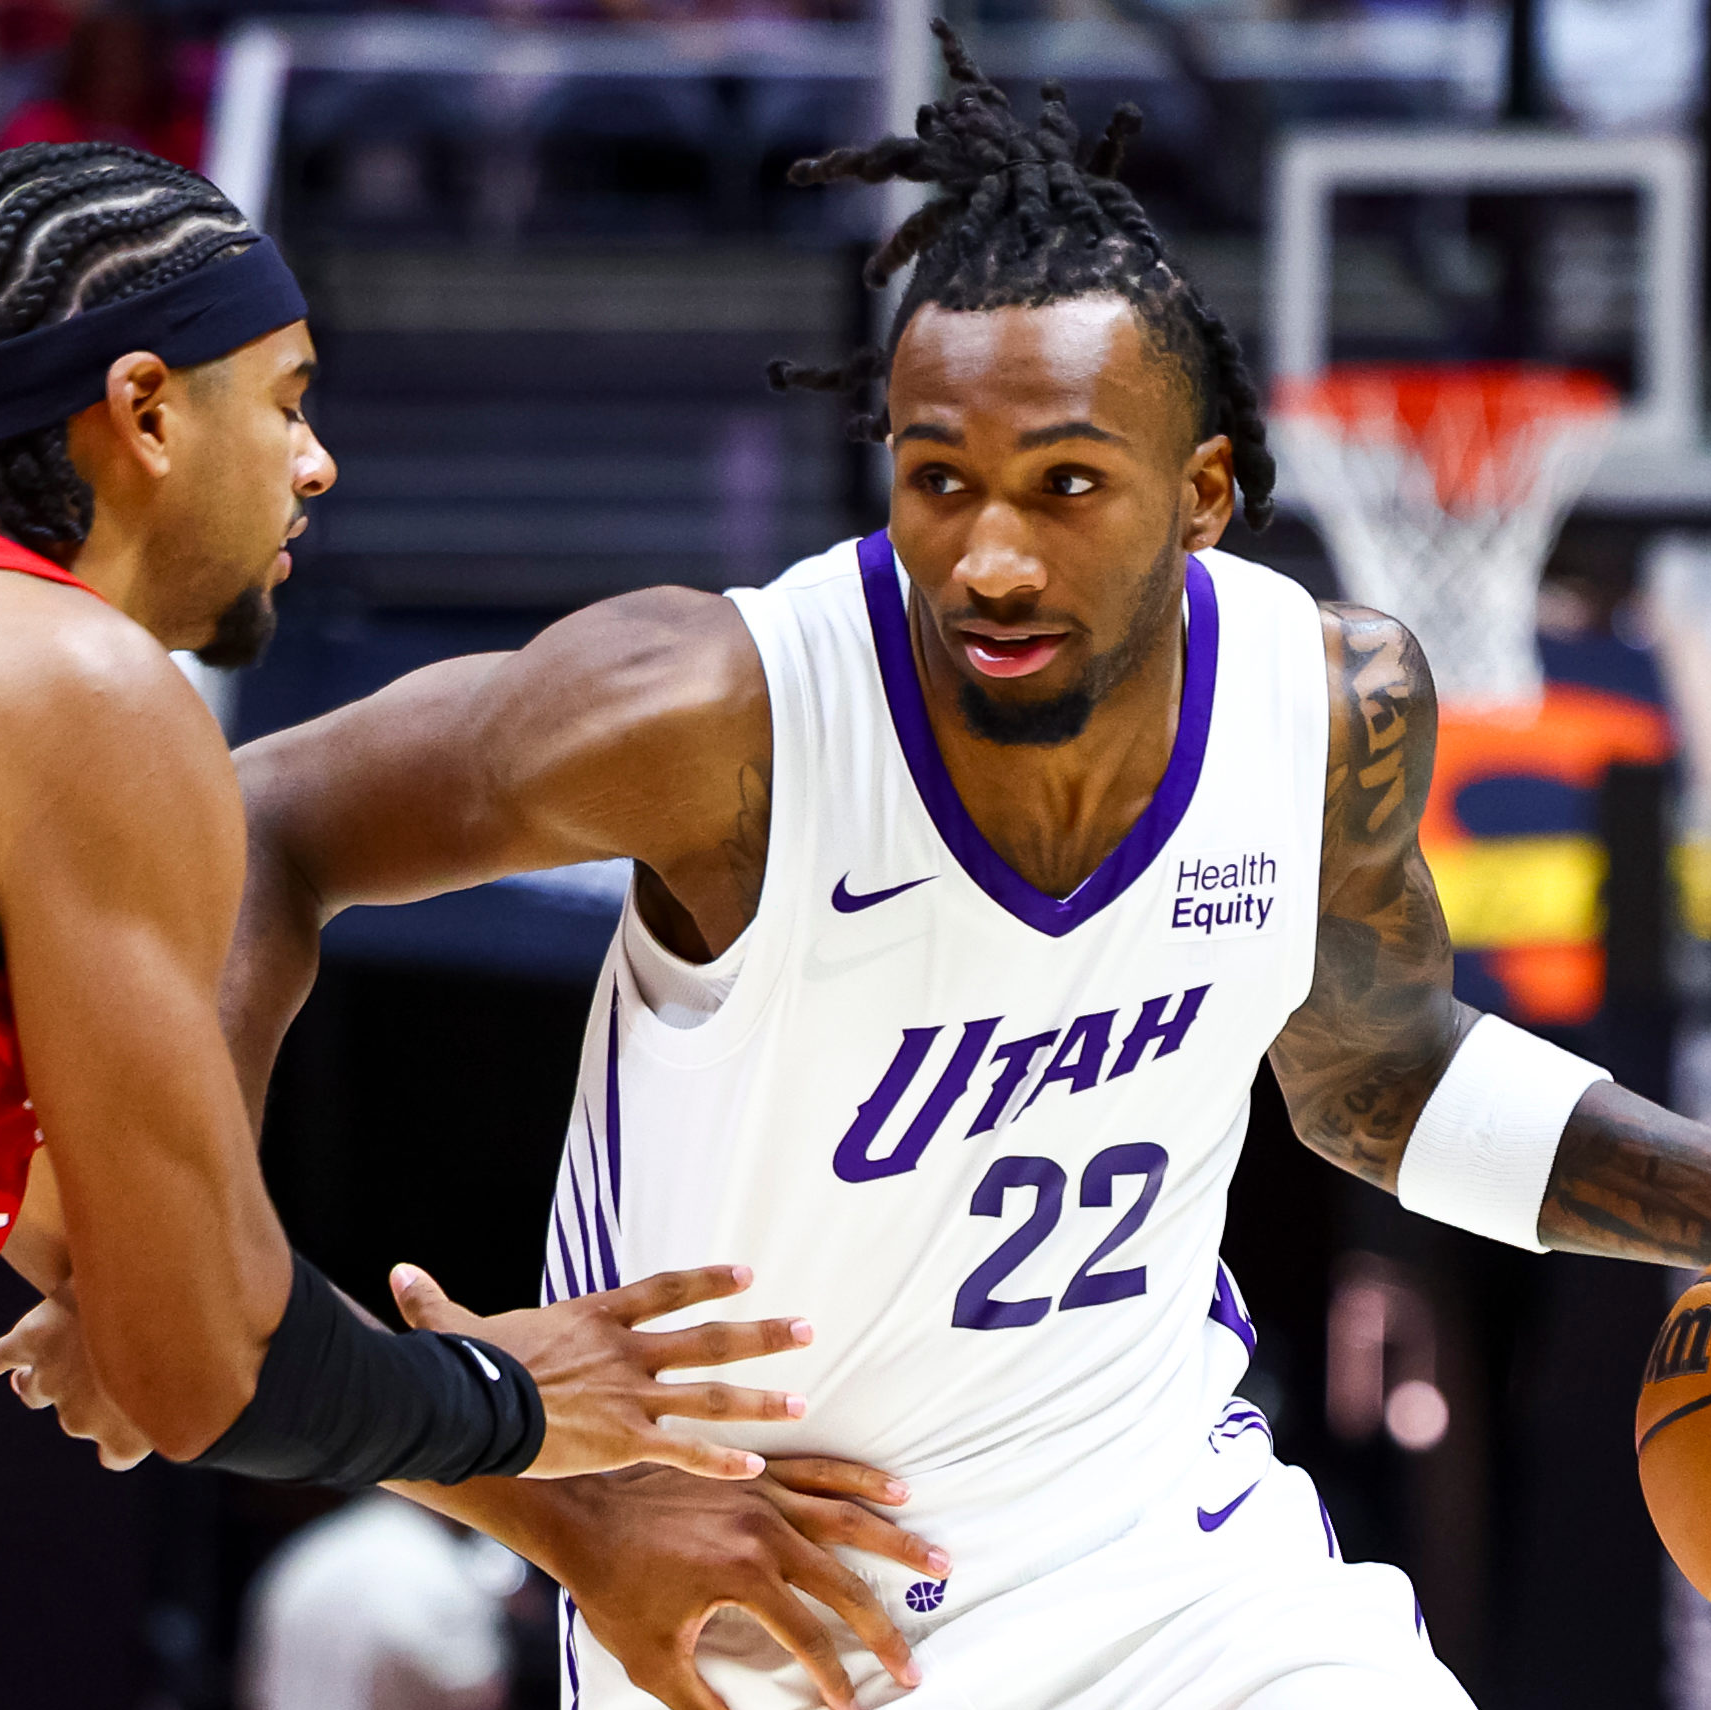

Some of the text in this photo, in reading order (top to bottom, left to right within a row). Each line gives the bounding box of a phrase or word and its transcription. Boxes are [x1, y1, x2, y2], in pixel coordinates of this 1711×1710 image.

[1176, 851, 1276, 893] Health
[1171, 893, 1274, 936] Equity
[950, 1141, 1169, 1332] 22
